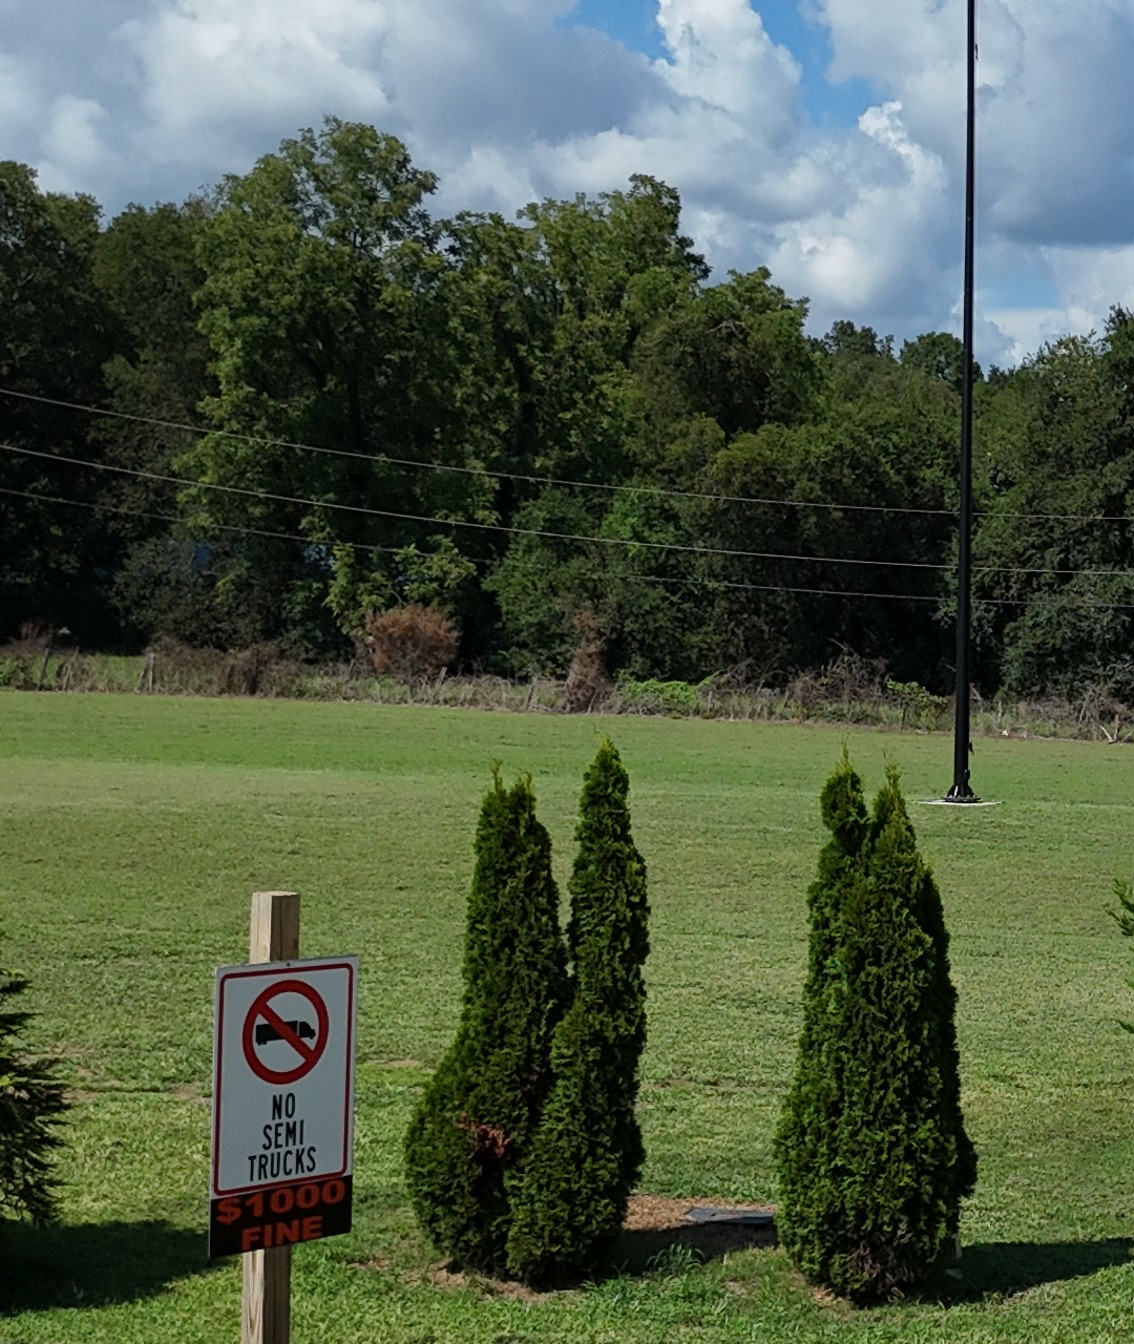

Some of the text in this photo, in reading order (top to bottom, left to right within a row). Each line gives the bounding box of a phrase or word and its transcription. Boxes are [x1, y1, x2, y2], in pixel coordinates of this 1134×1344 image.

[272, 1092, 296, 1121] NO
[262, 1119, 304, 1150] SEMI
[248, 1146, 316, 1181] TRUCKS
[216, 1180, 346, 1226] $1000
[241, 1215, 323, 1252] FINE
